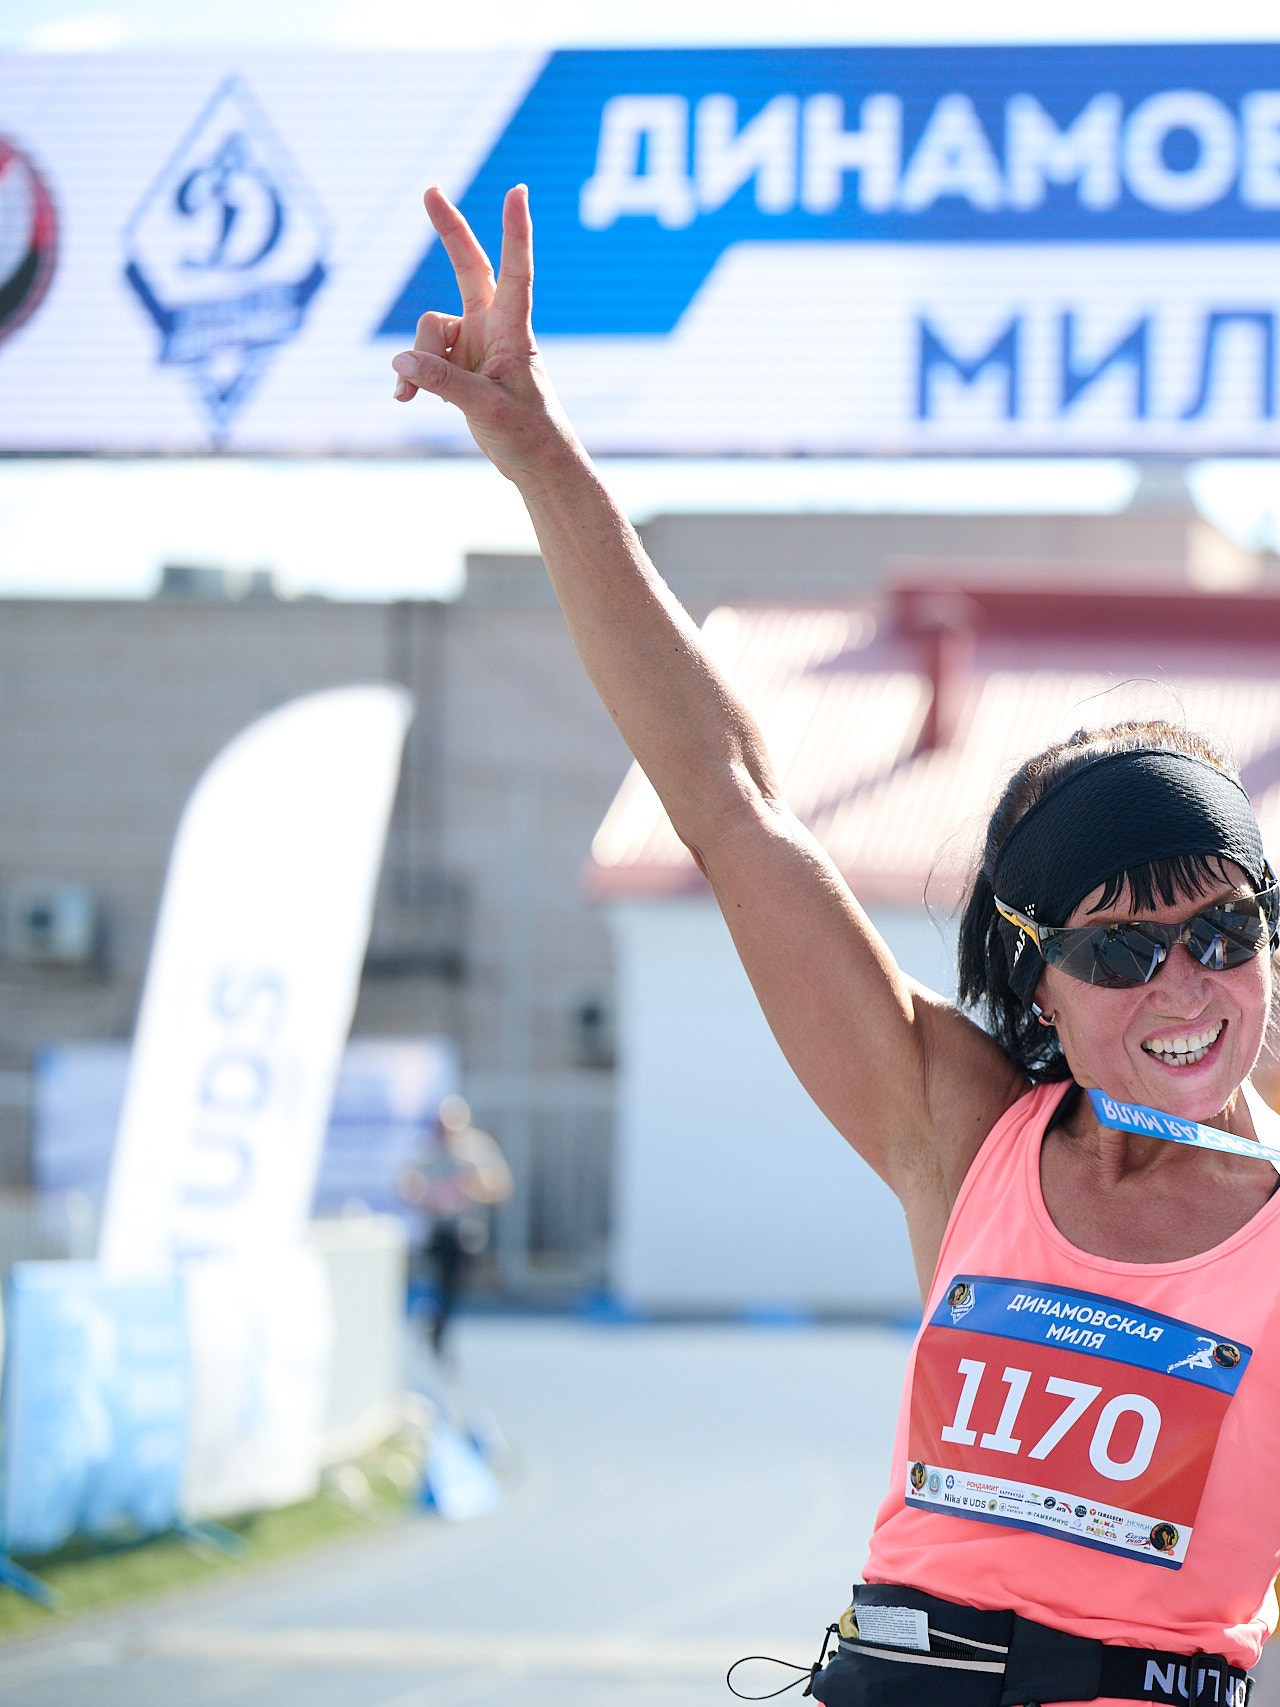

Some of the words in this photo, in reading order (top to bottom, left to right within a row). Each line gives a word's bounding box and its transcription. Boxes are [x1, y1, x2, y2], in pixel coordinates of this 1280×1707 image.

[1101, 1097, 1166, 1134] МИЛЯ
[1006, 1293, 1165, 1343] ДИНАМОВСКАЯ
[1045, 1322, 1107, 1351] МИЛЯ
[940, 1358, 1163, 1482] 1170
[969, 1498, 987, 1509] UDS
[1033, 1512, 1069, 1526] ГАМБРИНУС
